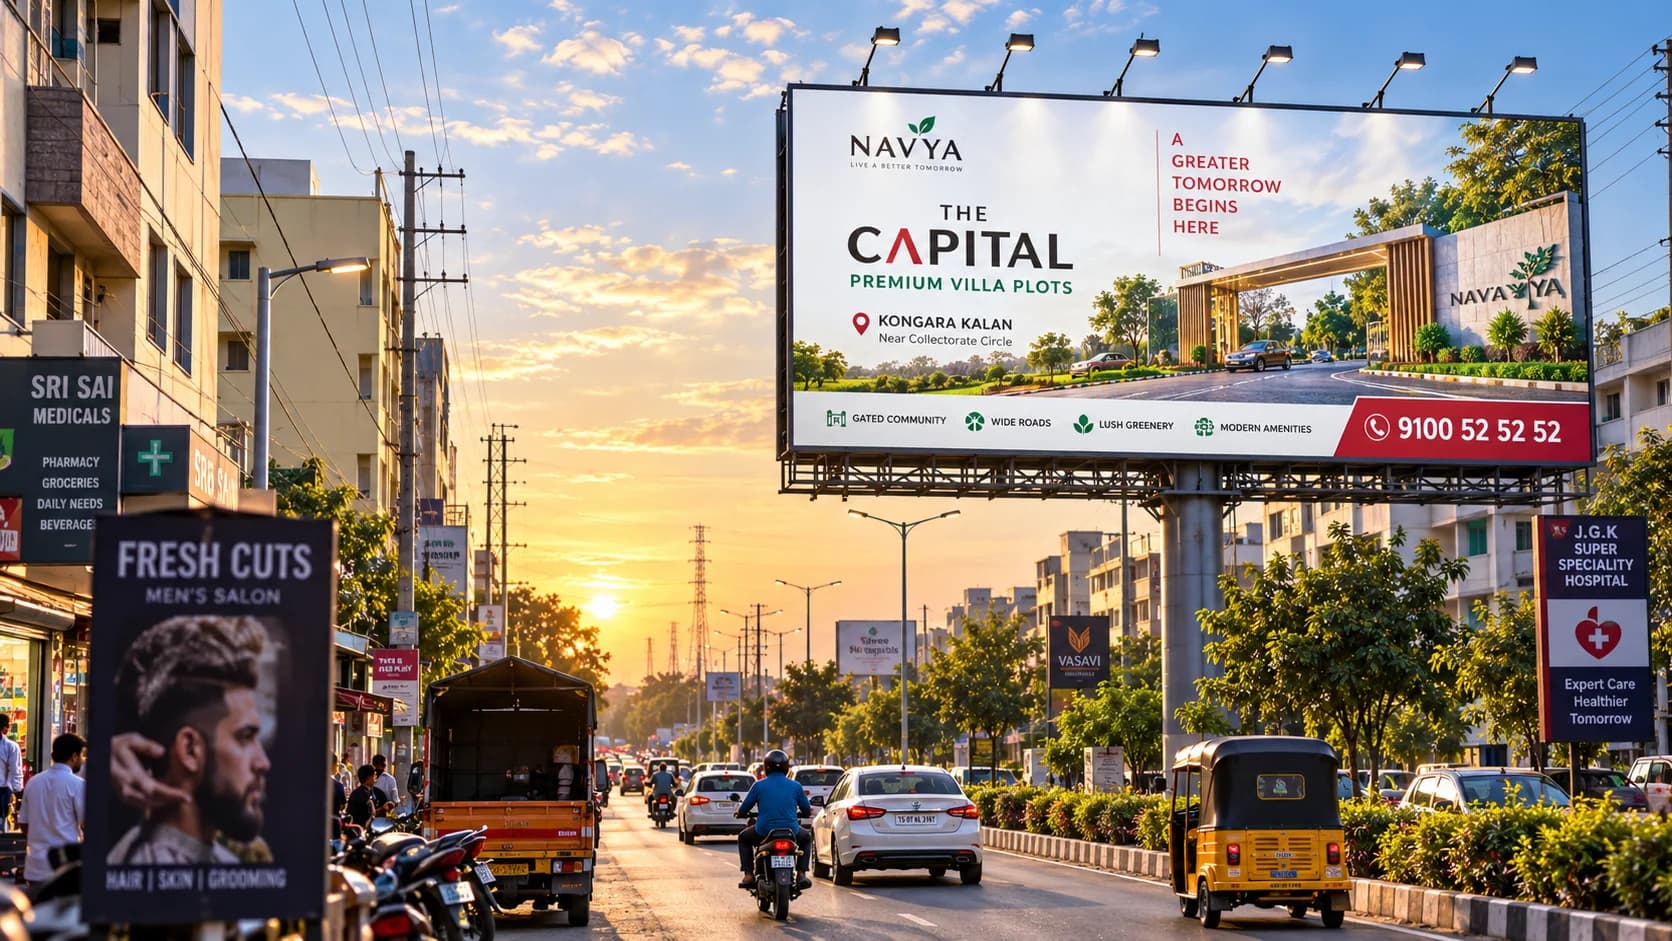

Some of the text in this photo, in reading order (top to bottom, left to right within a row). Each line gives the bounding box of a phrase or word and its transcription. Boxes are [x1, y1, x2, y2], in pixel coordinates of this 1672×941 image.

[1171, 133, 1184, 146] A
[850, 134, 963, 161] NAVYA
[1171, 154, 1250, 172] GREATER
[1172, 175, 1282, 194] TOMORROW
[940, 204, 988, 222] THE
[1173, 197, 1238, 215] BEGINS
[1173, 219, 1220, 235] HERE
[847, 226, 1074, 270] CAPITAL
[850, 274, 1073, 295] PREMIUM VILLA PLOTS
[878, 314, 1013, 331] KONGARA KALAN
[878, 332, 1013, 347] Near Collectorate Circle
[31, 374, 113, 400] SRI SAI
[33, 407, 111, 425] MEDICALS
[852, 413, 947, 426] GATED COMMUNITY
[991, 416, 1052, 429] WIDE ROADS
[1099, 420, 1174, 430] LUSH GREENERY
[1220, 423, 1312, 434] MODERN AMENITIES
[1398, 416, 1562, 444] 9100 52 52 52
[42, 456, 100, 468] PHARMACY
[42, 477, 99, 489] GROCERIES
[37, 498, 103, 510] DAILY NEEDS
[1574, 525, 1618, 539] J.G.K
[1574, 542, 1618, 555] SUPER
[118, 540, 312, 580] FRESH CUTS
[1558, 558, 1634, 571] SPECIALITY
[1565, 574, 1629, 587] HOSPITAL
[146, 587, 281, 606] MEN'S SALON
[1058, 655, 1101, 667] VASAVI
[1565, 678, 1636, 693] Expert Care
[1574, 695, 1629, 708] Healthier
[1569, 712, 1633, 725] Tomorrow
[106, 867, 287, 890] HAIR SKIN GROOMING
